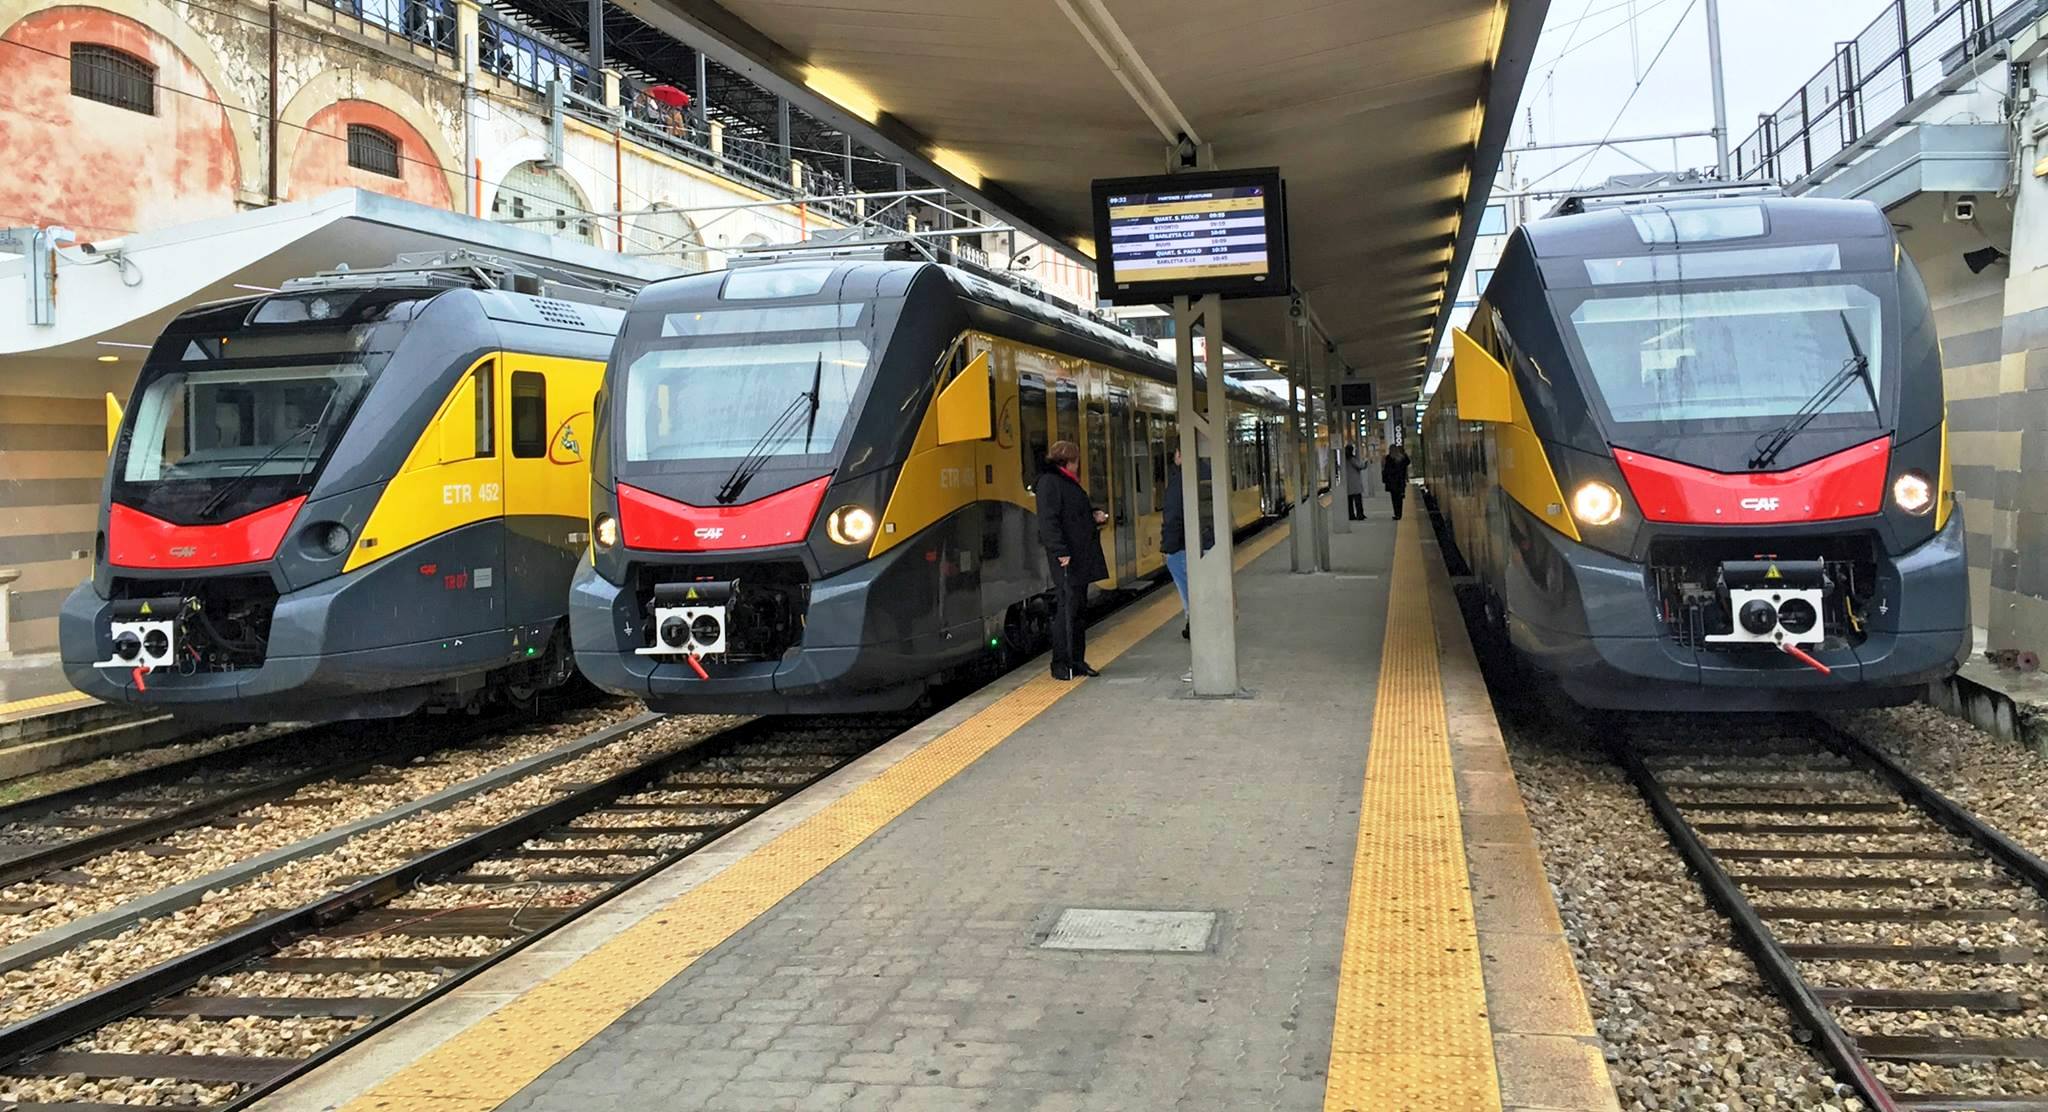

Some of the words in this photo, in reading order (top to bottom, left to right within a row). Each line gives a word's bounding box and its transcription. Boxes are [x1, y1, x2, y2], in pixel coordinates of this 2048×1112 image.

[1153, 215, 1175, 223] QUART.
[1154, 232, 1182, 240] BARLETTA
[940, 467, 960, 489] ETR
[443, 485, 472, 505] ETR
[479, 483, 499, 502] 452
[1740, 497, 1780, 511] CAF
[694, 527, 725, 540] CAF
